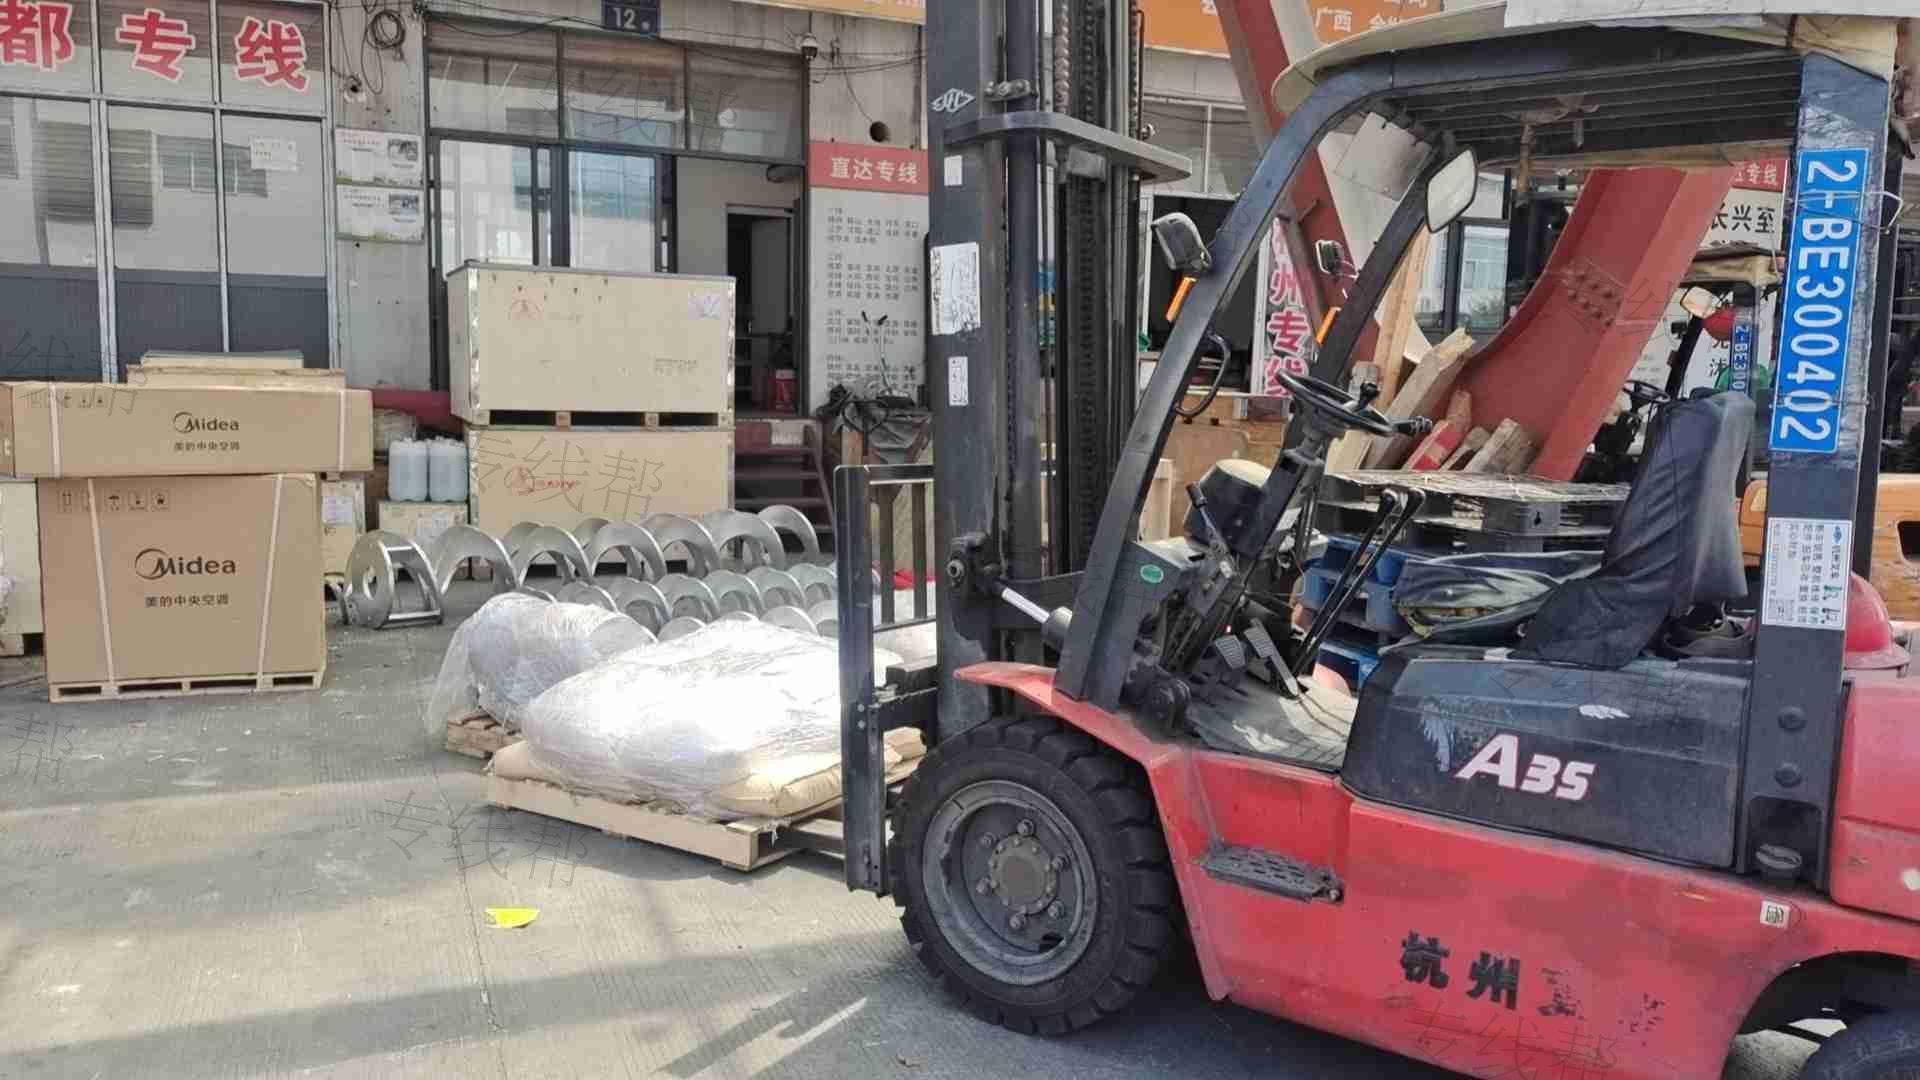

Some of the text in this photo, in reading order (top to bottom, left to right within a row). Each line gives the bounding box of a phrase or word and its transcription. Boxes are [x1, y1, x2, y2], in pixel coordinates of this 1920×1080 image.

[1315, 7, 1352, 33] 广西
[831, 156, 919, 184] 直达专线
[1712, 203, 1776, 234] 长兴至
[1264, 219, 1311, 397] 州专线
[1780, 159, 1858, 441] 2-BE300402
[1732, 325, 1750, 389] 2-BE300
[173, 411, 240, 434] Midea
[174, 441, 240, 451] 美的中央空调
[135, 548, 236, 580] Midea
[145, 594, 230, 608] 美的中央空调
[1454, 732, 1596, 801] A35
[1400, 931, 1521, 1011] 杭州
